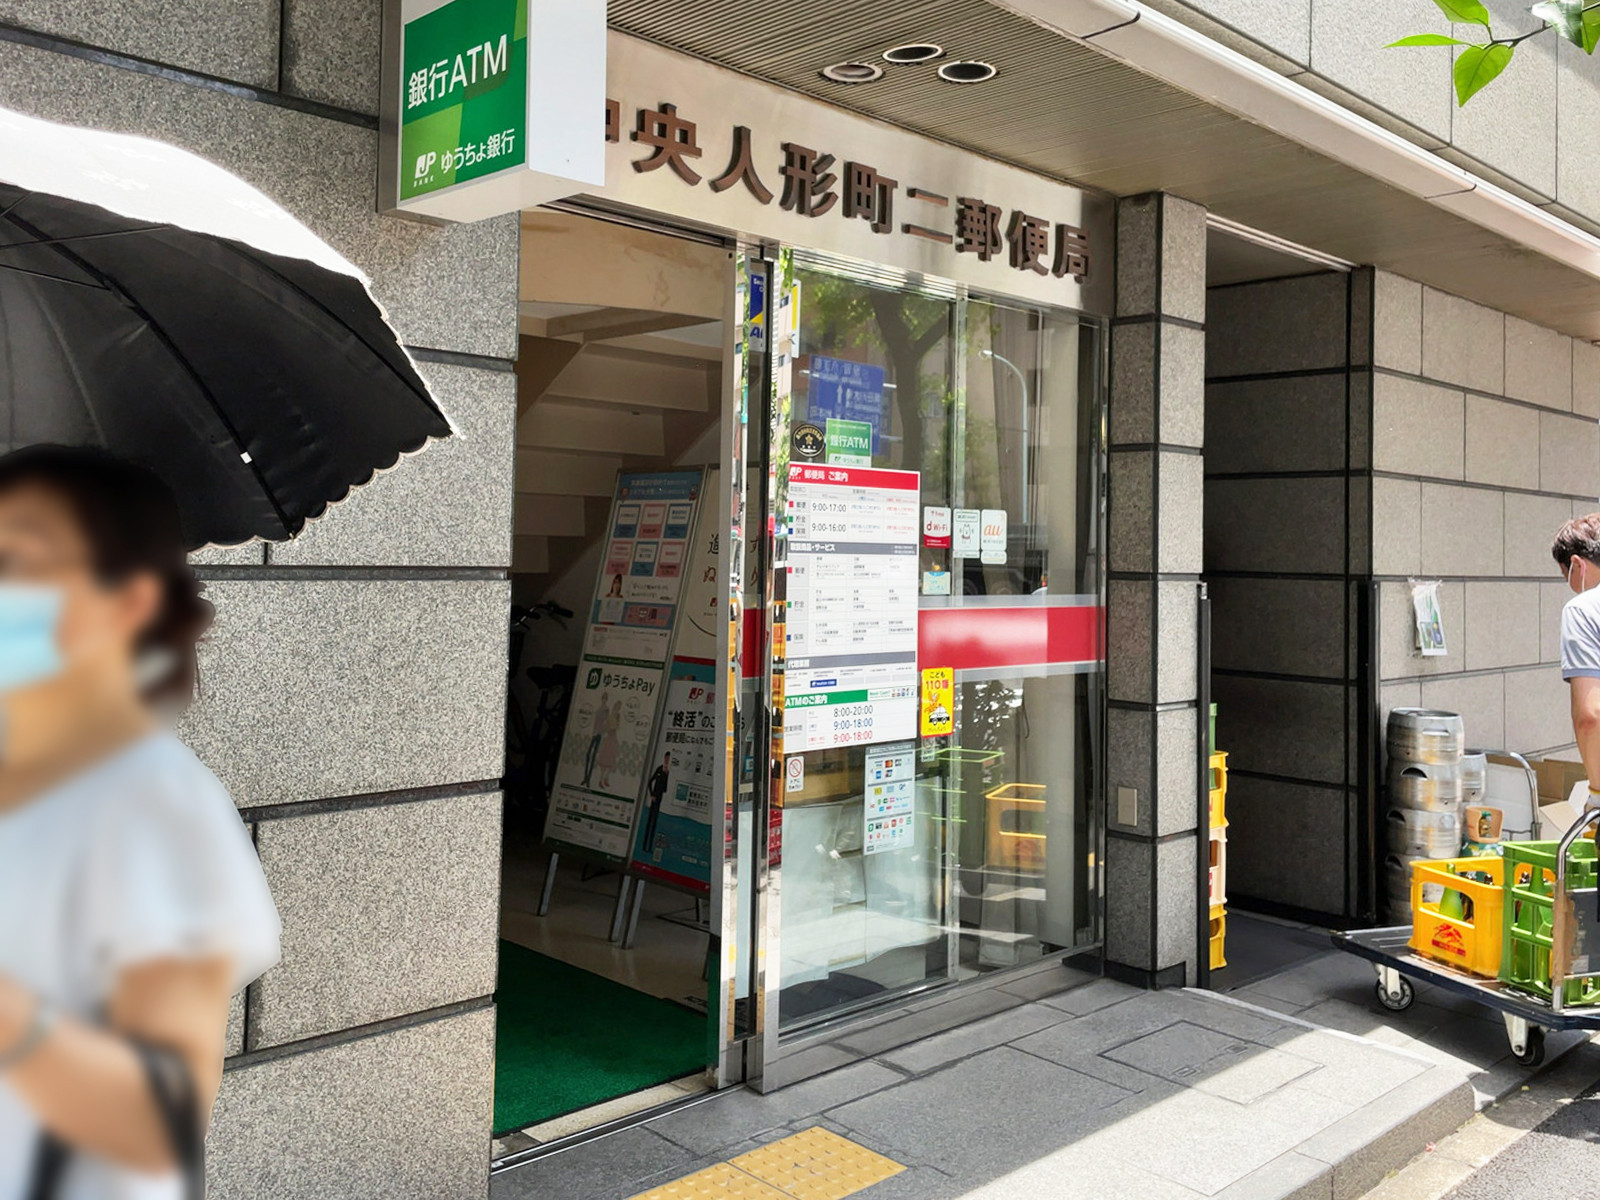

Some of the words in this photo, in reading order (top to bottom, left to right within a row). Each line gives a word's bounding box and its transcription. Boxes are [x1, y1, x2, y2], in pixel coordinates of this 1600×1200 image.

[407, 34, 508, 110] 銀行ATM
[441, 128, 516, 174] ゆうちょ銀行
[605, 101, 1091, 284] 央人形町二郵便局
[830, 434, 869, 449] 銀行ATM
[828, 471, 849, 482] ご案内
[812, 502, 847, 513] 9:00-17:00
[983, 524, 1003, 537] au
[603, 672, 656, 697] ゆうちょPay
[785, 694, 828, 707] ATMのご案内
[833, 705, 874, 718] 8:00-20:00
[833, 717, 873, 731] 9:00-18:00
[833, 730, 873, 744] 9:00-18:00
